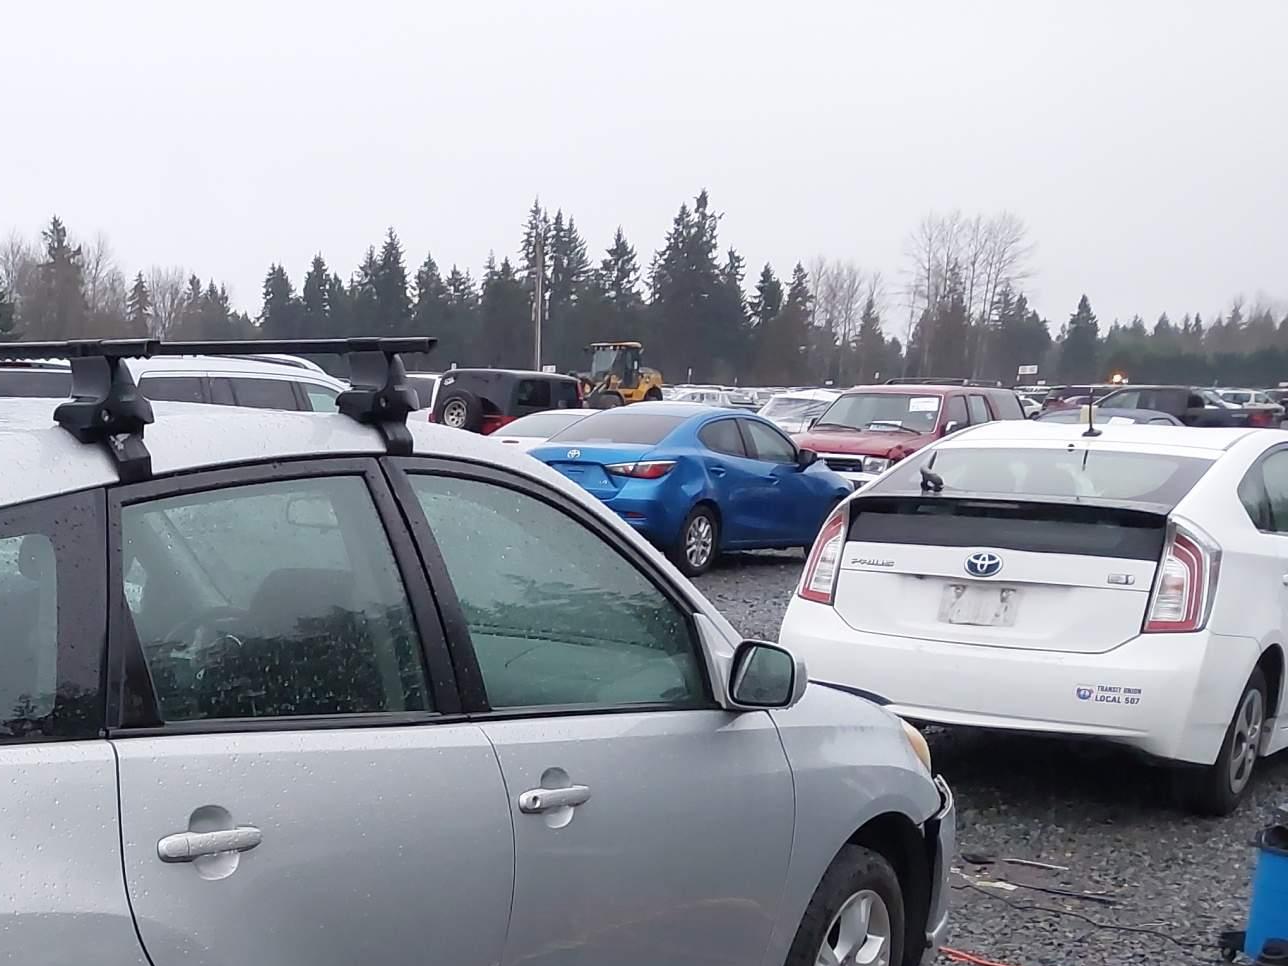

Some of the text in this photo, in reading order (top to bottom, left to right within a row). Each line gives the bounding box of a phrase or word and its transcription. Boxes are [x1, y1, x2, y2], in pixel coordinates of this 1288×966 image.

[1097, 685, 1122, 694] TRANSIT
[1095, 694, 1141, 705] LOCAL 507
